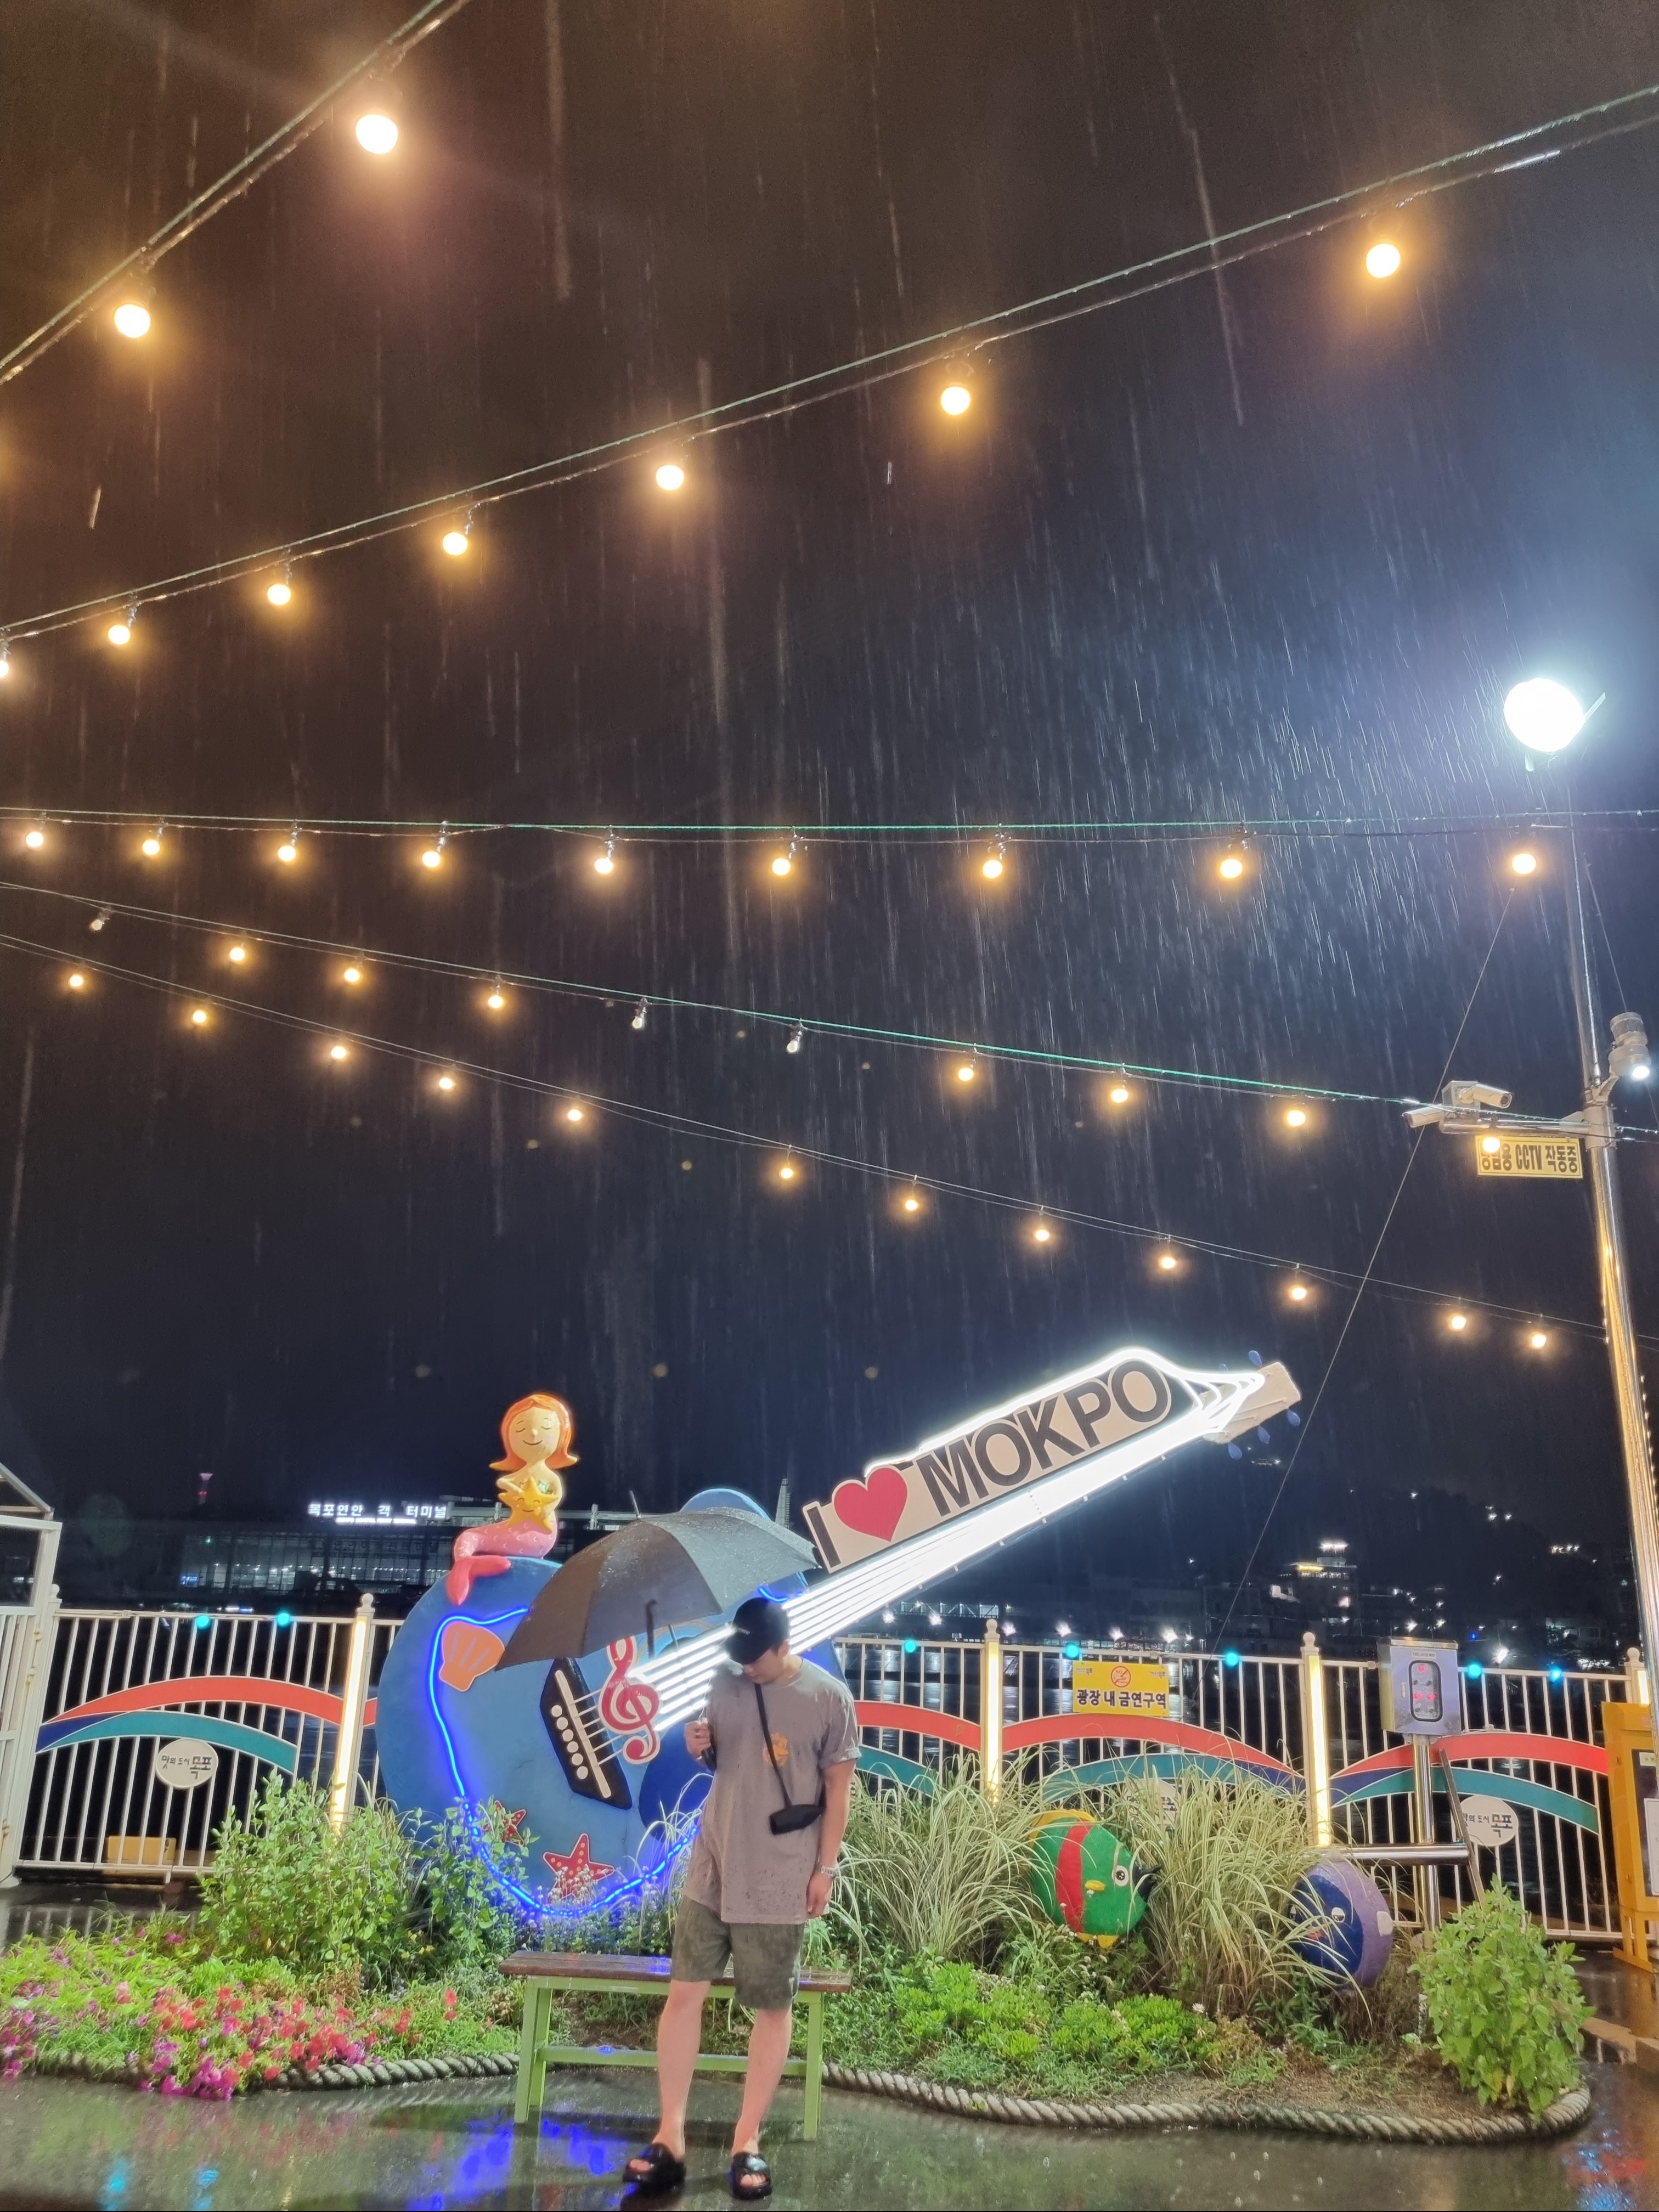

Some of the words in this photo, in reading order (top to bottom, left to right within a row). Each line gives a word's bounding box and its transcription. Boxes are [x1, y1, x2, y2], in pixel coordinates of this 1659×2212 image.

[1515, 1144, 1542, 1170] CCTV
[1545, 1145, 1578, 1173] 작동중
[806, 1505, 842, 1568] I
[916, 1360, 1169, 1517] MOKPO
[406, 1505, 447, 1519] 터미널
[1076, 1689, 1101, 1706] 광장
[1104, 1690, 1115, 1706] 내
[1119, 1691, 1166, 1709] 금연구역
[161, 1755, 176, 1769] 맛의
[178, 1757, 190, 1765] 도시
[190, 1756, 212, 1779] 목포
[1477, 1815, 1489, 1823] 도시
[1491, 1814, 1513, 1838] 목포
